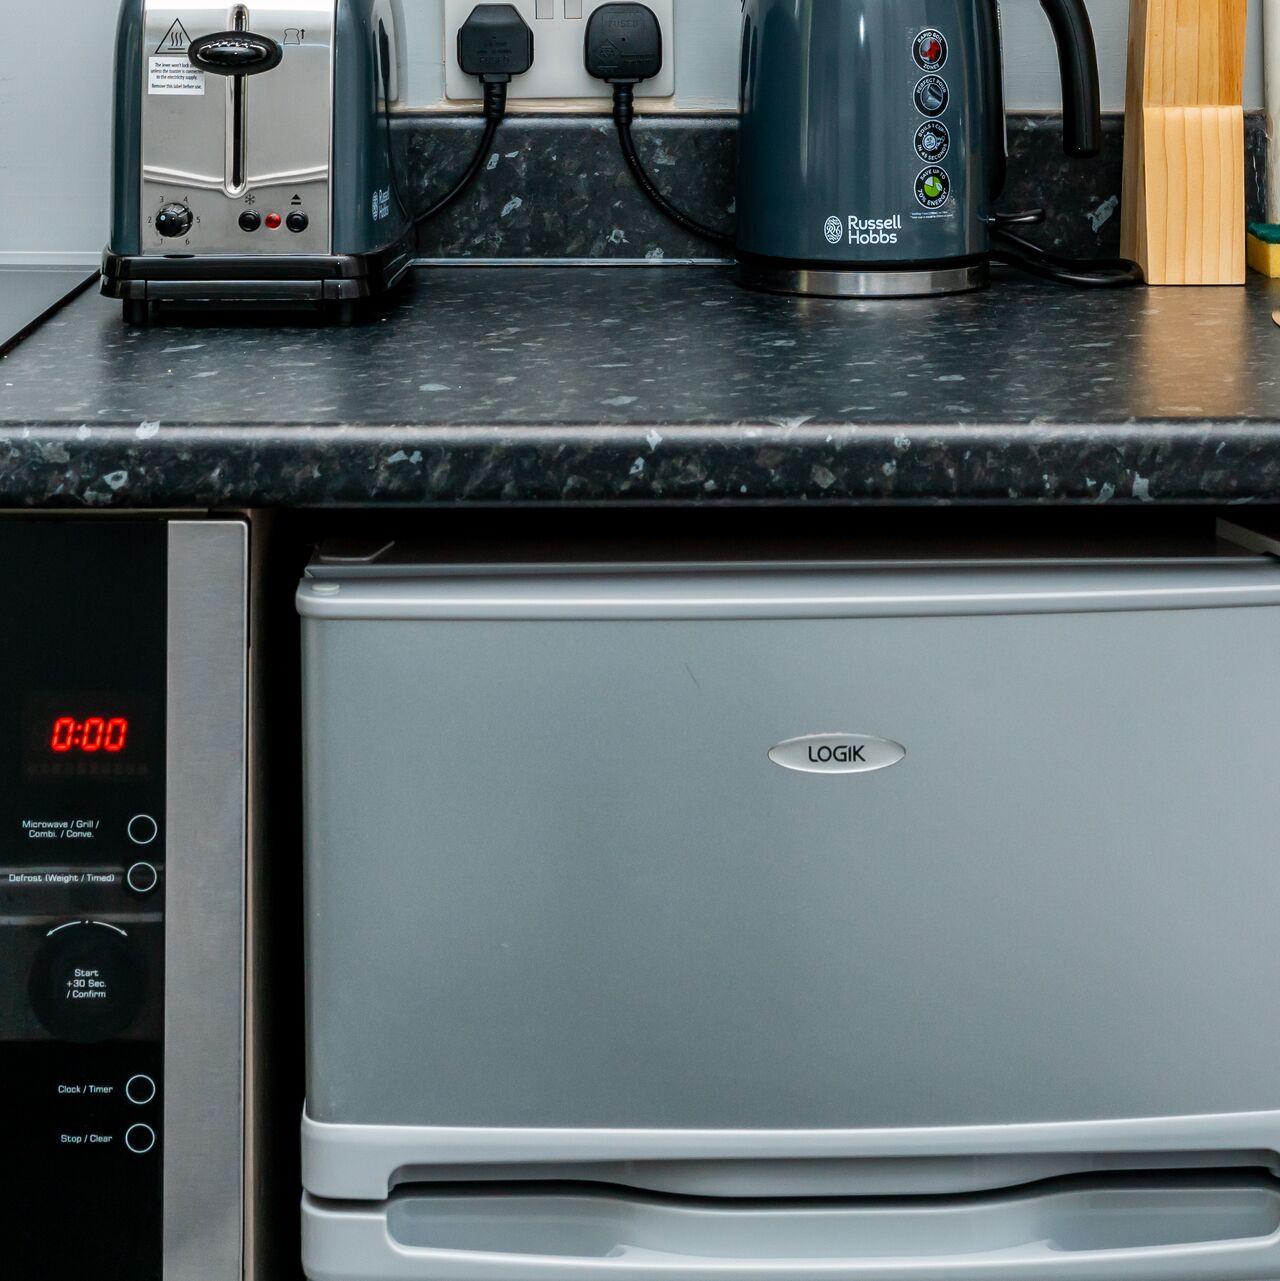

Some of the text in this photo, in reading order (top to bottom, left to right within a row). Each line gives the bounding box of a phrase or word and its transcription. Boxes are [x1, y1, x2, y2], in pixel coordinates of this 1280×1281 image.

[848, 214, 902, 230] Russell
[848, 229, 898, 245] Hobbs
[51, 716, 128, 752] 0:00
[808, 745, 866, 762] LOGIK
[22, 820, 68, 829] Microwave
[76, 820, 94, 829] Grill
[29, 829, 57, 838] Combi.
[66, 830, 94, 838] Conve.
[9, 874, 42, 882] Defrost
[45, 874, 78, 884] (Weight
[86, 874, 115, 883] Timed)
[74, 969, 99, 977] Start
[88, 979, 107, 988] Sec.
[72, 990, 106, 998] Confirm
[58, 1085, 81, 1093] Clock
[89, 1085, 113, 1093] Timer
[60, 1134, 82, 1144] Stop
[89, 1134, 113, 1143] Clear
